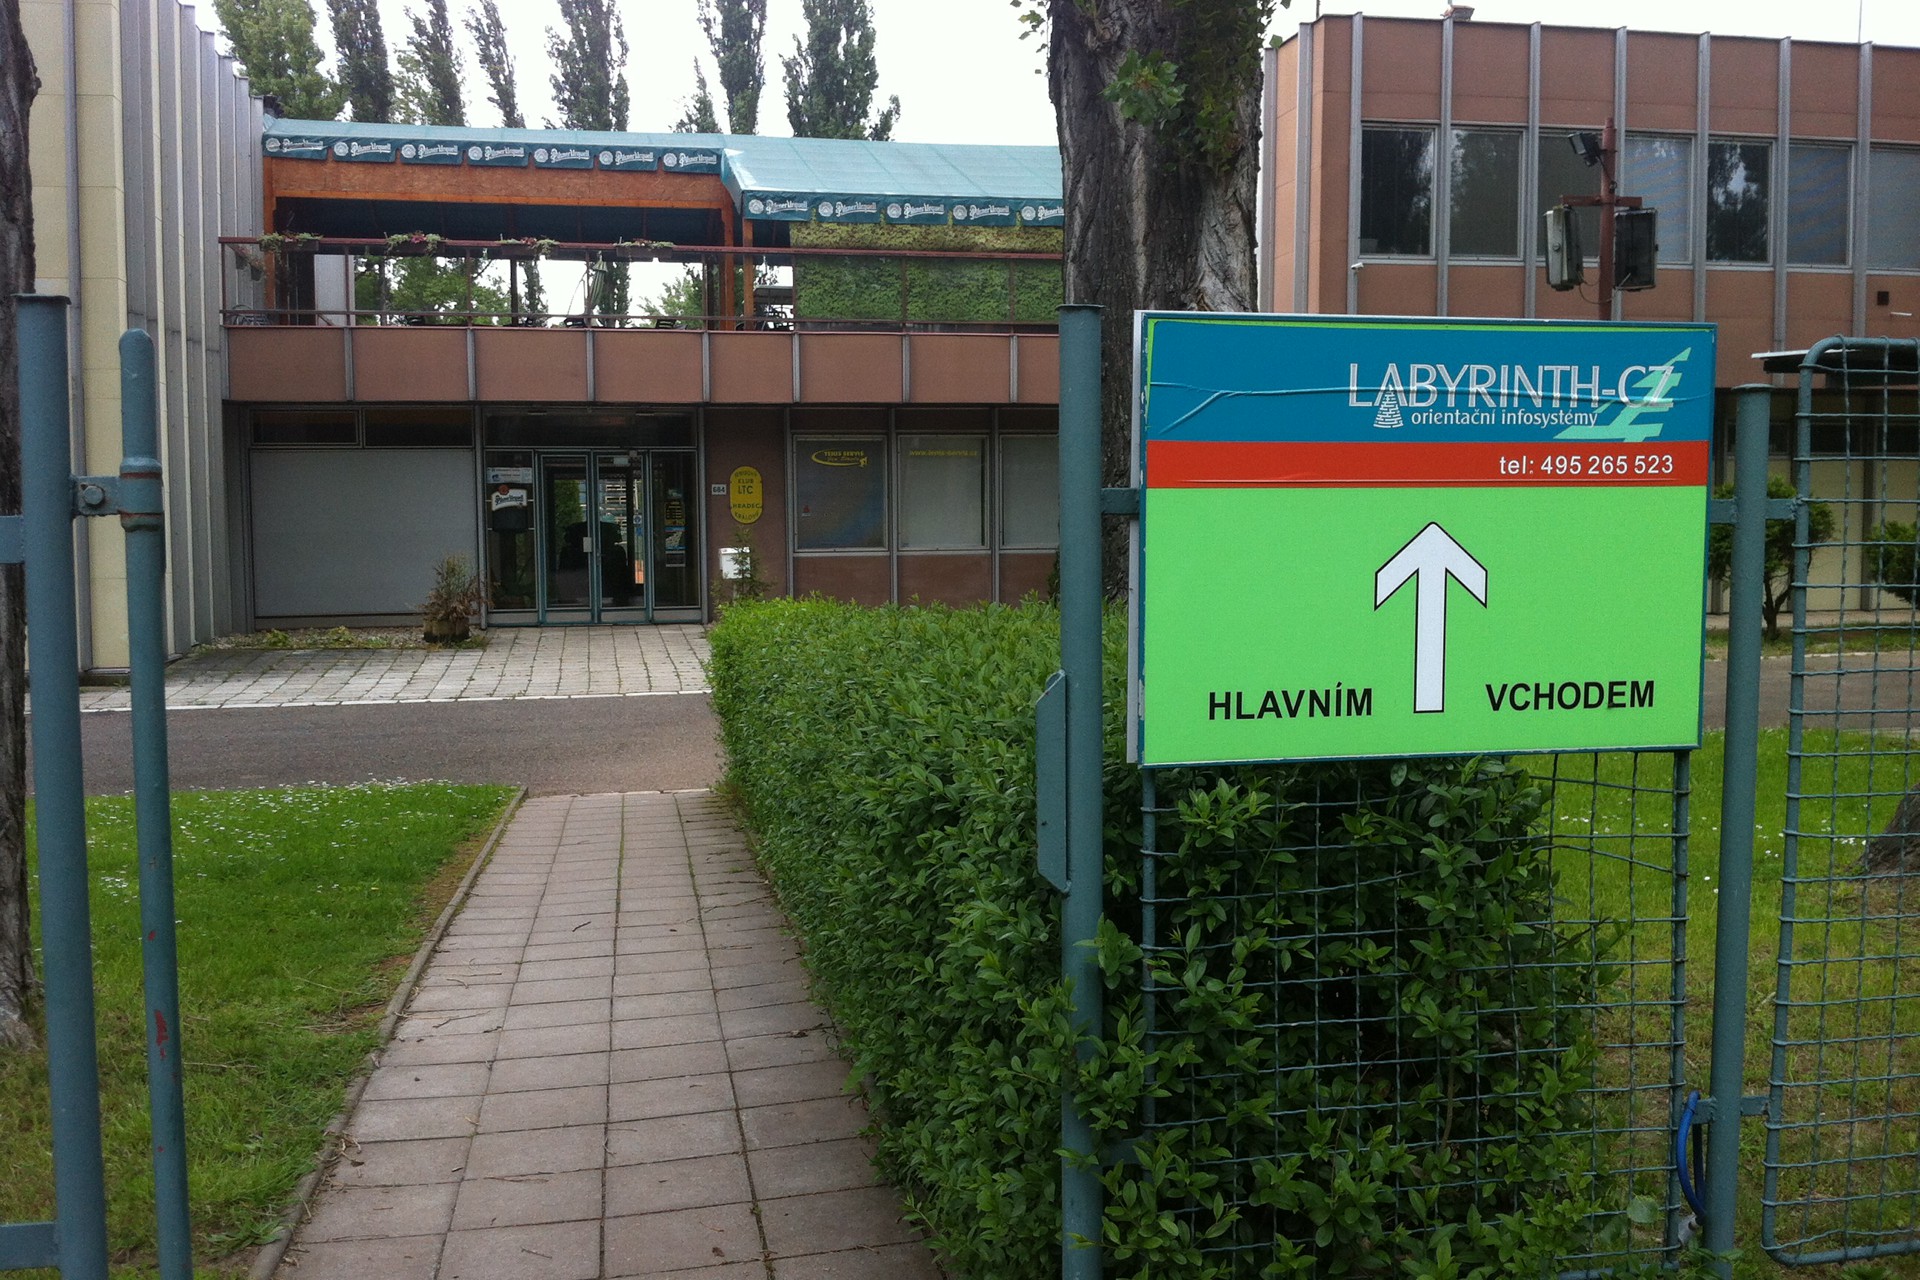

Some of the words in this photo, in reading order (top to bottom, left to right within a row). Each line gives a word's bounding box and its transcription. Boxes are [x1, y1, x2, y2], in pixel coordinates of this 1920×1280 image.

[1348, 362, 1675, 409] LABYRINTH-CZ
[1411, 407, 1496, 426] orientační
[1501, 407, 1599, 429] infosystémy
[1499, 456, 1535, 475] tel:
[1540, 456, 1582, 475] 495
[1588, 456, 1629, 474] 265
[1634, 455, 1675, 473] 523
[737, 485, 754, 495] LTC
[1208, 682, 1374, 721] HLAVNÍM
[1484, 680, 1656, 712] VCHODEM
